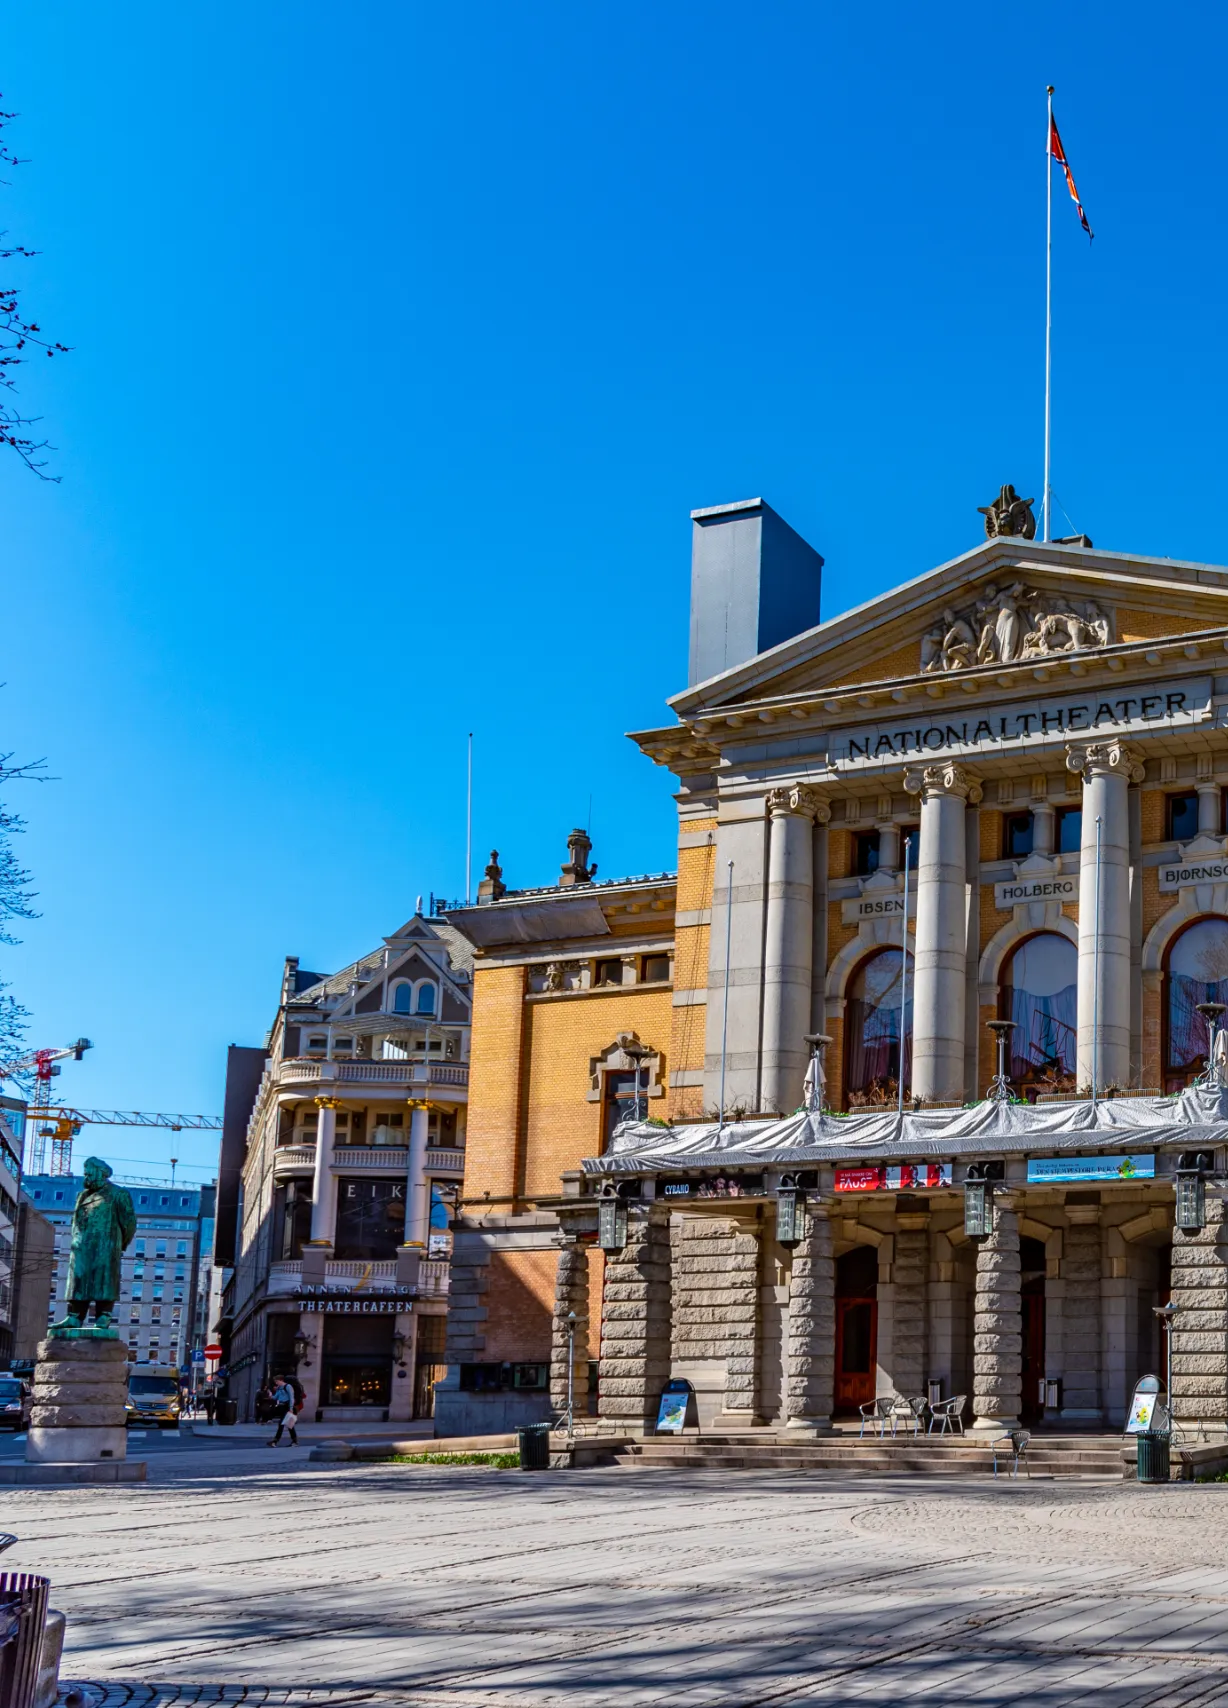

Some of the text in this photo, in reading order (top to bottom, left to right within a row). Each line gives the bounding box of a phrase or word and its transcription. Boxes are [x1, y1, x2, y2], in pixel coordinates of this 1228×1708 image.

[848, 692, 1190, 762] NATIONALTHEATER
[1003, 881, 1073, 899] HOLBERG
[859, 900, 905, 914] IBSEN
[665, 1184, 690, 1194] CYRANO
[840, 1177, 872, 1189] FAUST
[294, 1285, 351, 1293] ANNEN
[298, 1300, 414, 1312] THEATERCAFEEN
[196, 1352, 202, 1360] P
